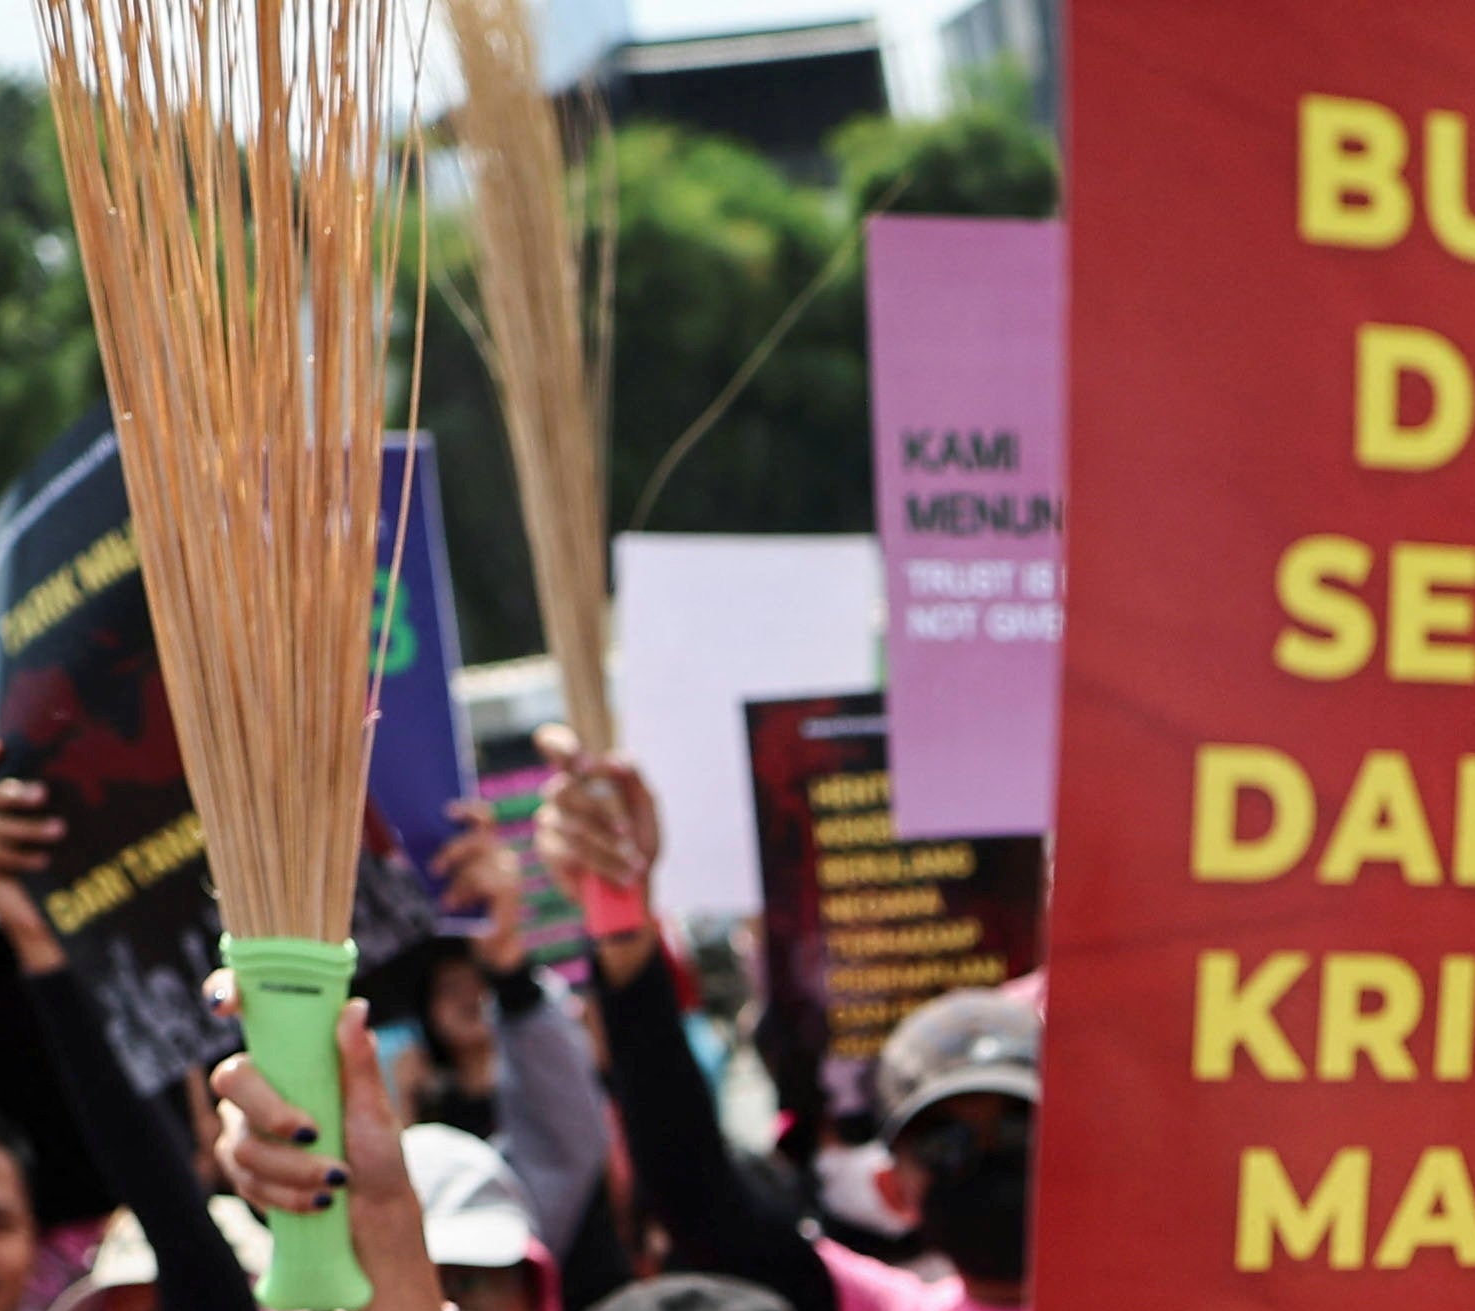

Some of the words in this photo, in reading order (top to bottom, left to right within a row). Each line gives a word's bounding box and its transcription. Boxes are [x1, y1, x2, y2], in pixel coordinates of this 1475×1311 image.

[901, 426, 1019, 474] KAMI
[904, 491, 1065, 540] MENUN
[983, 602, 1064, 645] GIVE
